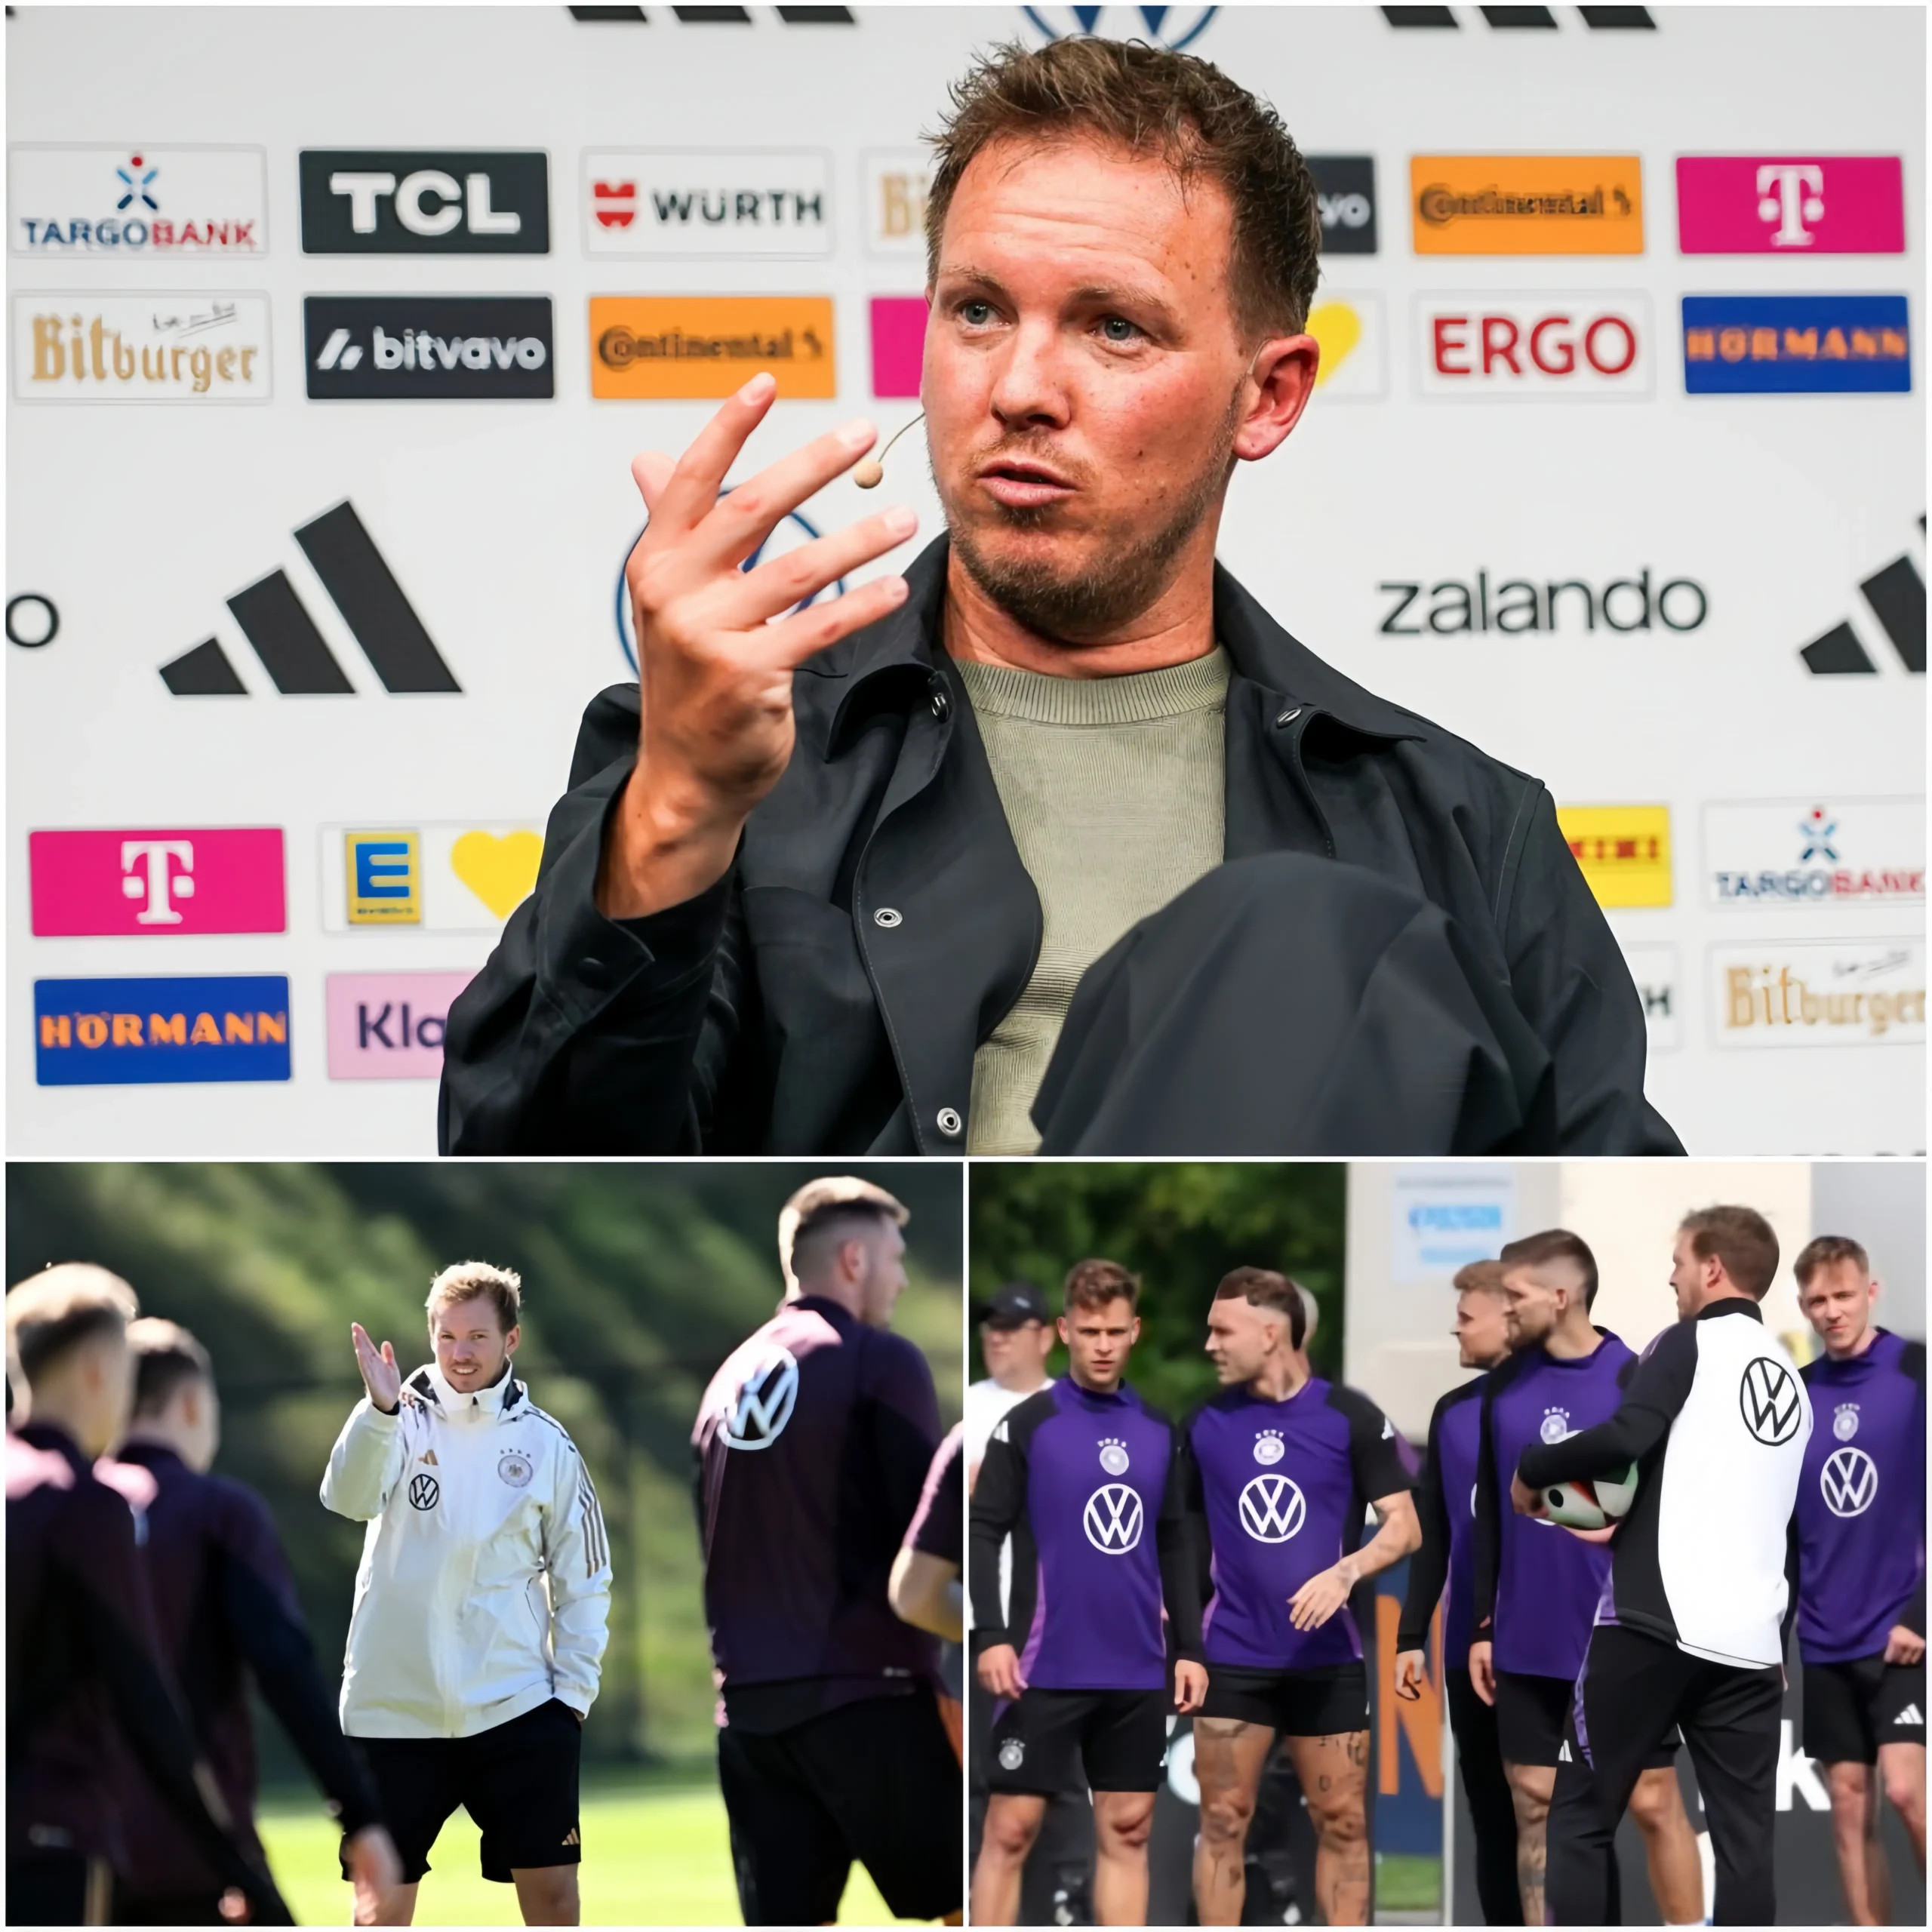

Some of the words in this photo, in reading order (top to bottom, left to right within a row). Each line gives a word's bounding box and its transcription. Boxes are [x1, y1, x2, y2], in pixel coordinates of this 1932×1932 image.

[20, 218, 257, 245] TARGOBANK
[331, 170, 521, 235] TCL
[32, 314, 258, 392] Bitburger
[373, 326, 546, 371] bitvavo
[1432, 317, 1636, 374] ERGO
[1376, 566, 1709, 634] zalando
[355, 841, 410, 899] E
